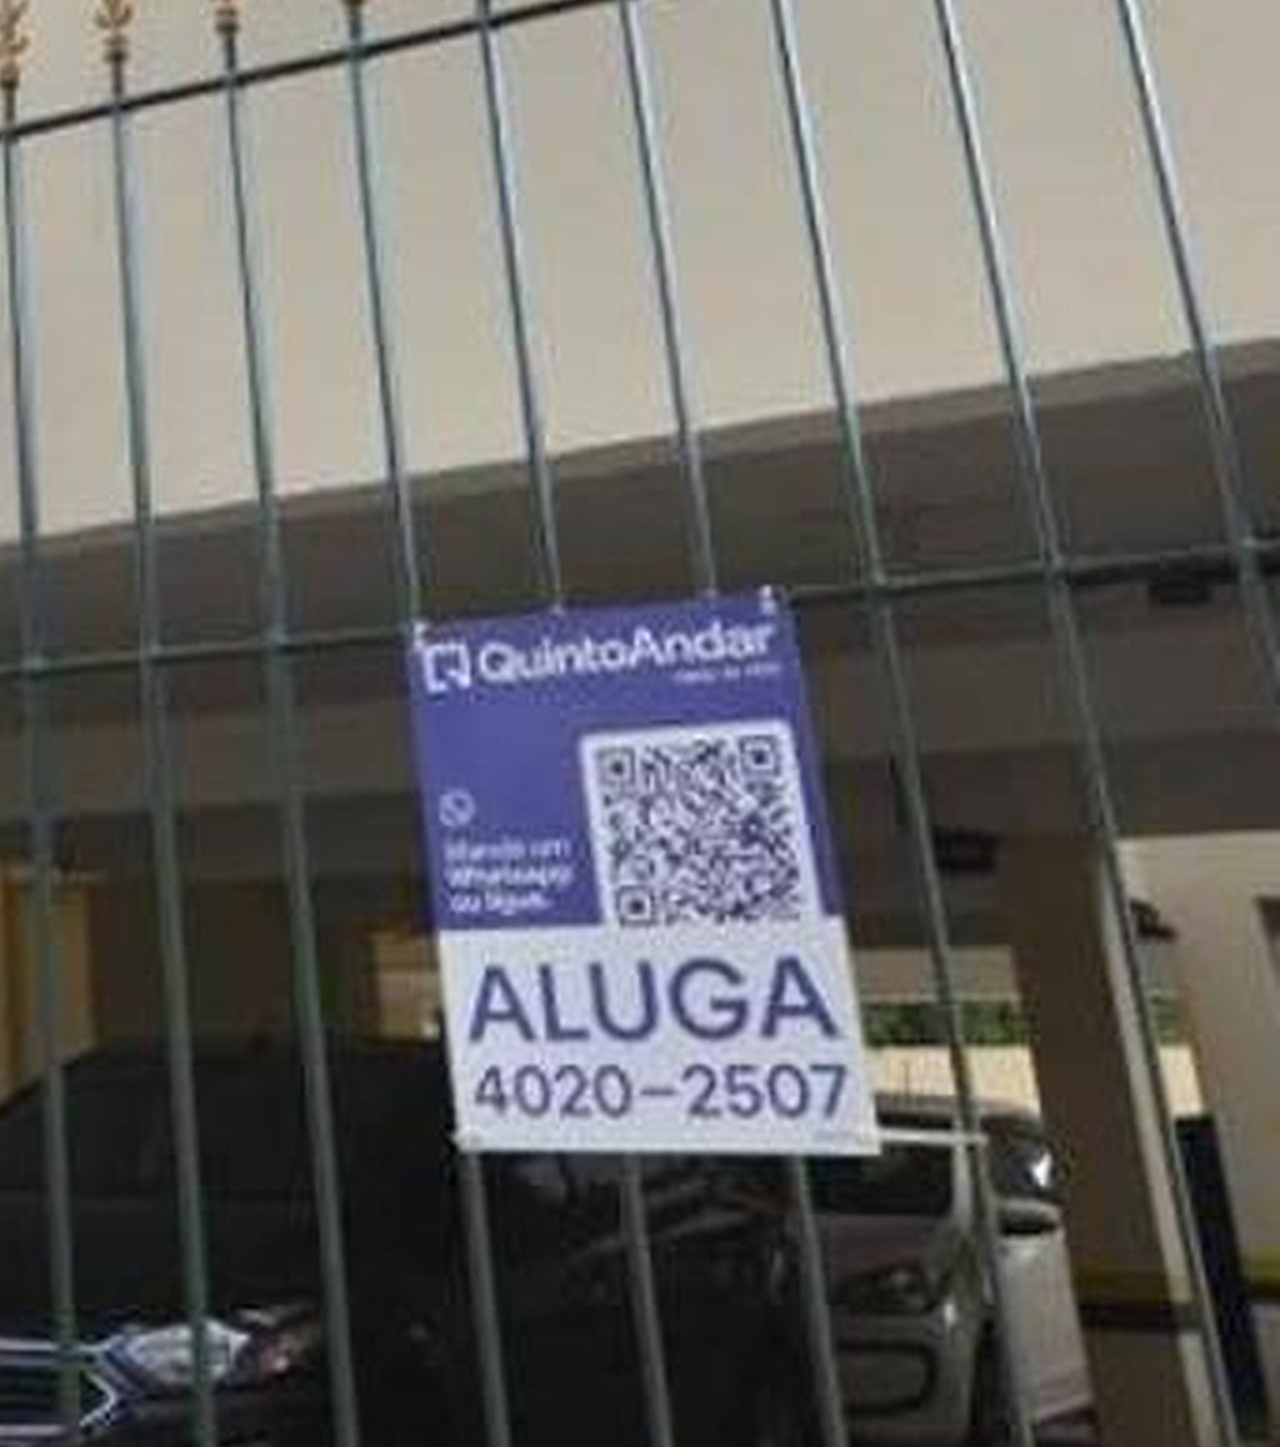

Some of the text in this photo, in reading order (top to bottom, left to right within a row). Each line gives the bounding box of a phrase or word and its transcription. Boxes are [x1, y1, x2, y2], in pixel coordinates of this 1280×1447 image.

[478, 620, 776, 683] QuintoAndar
[469, 955, 840, 1042] ALUGA
[473, 1063, 848, 1122] 4020-2507
